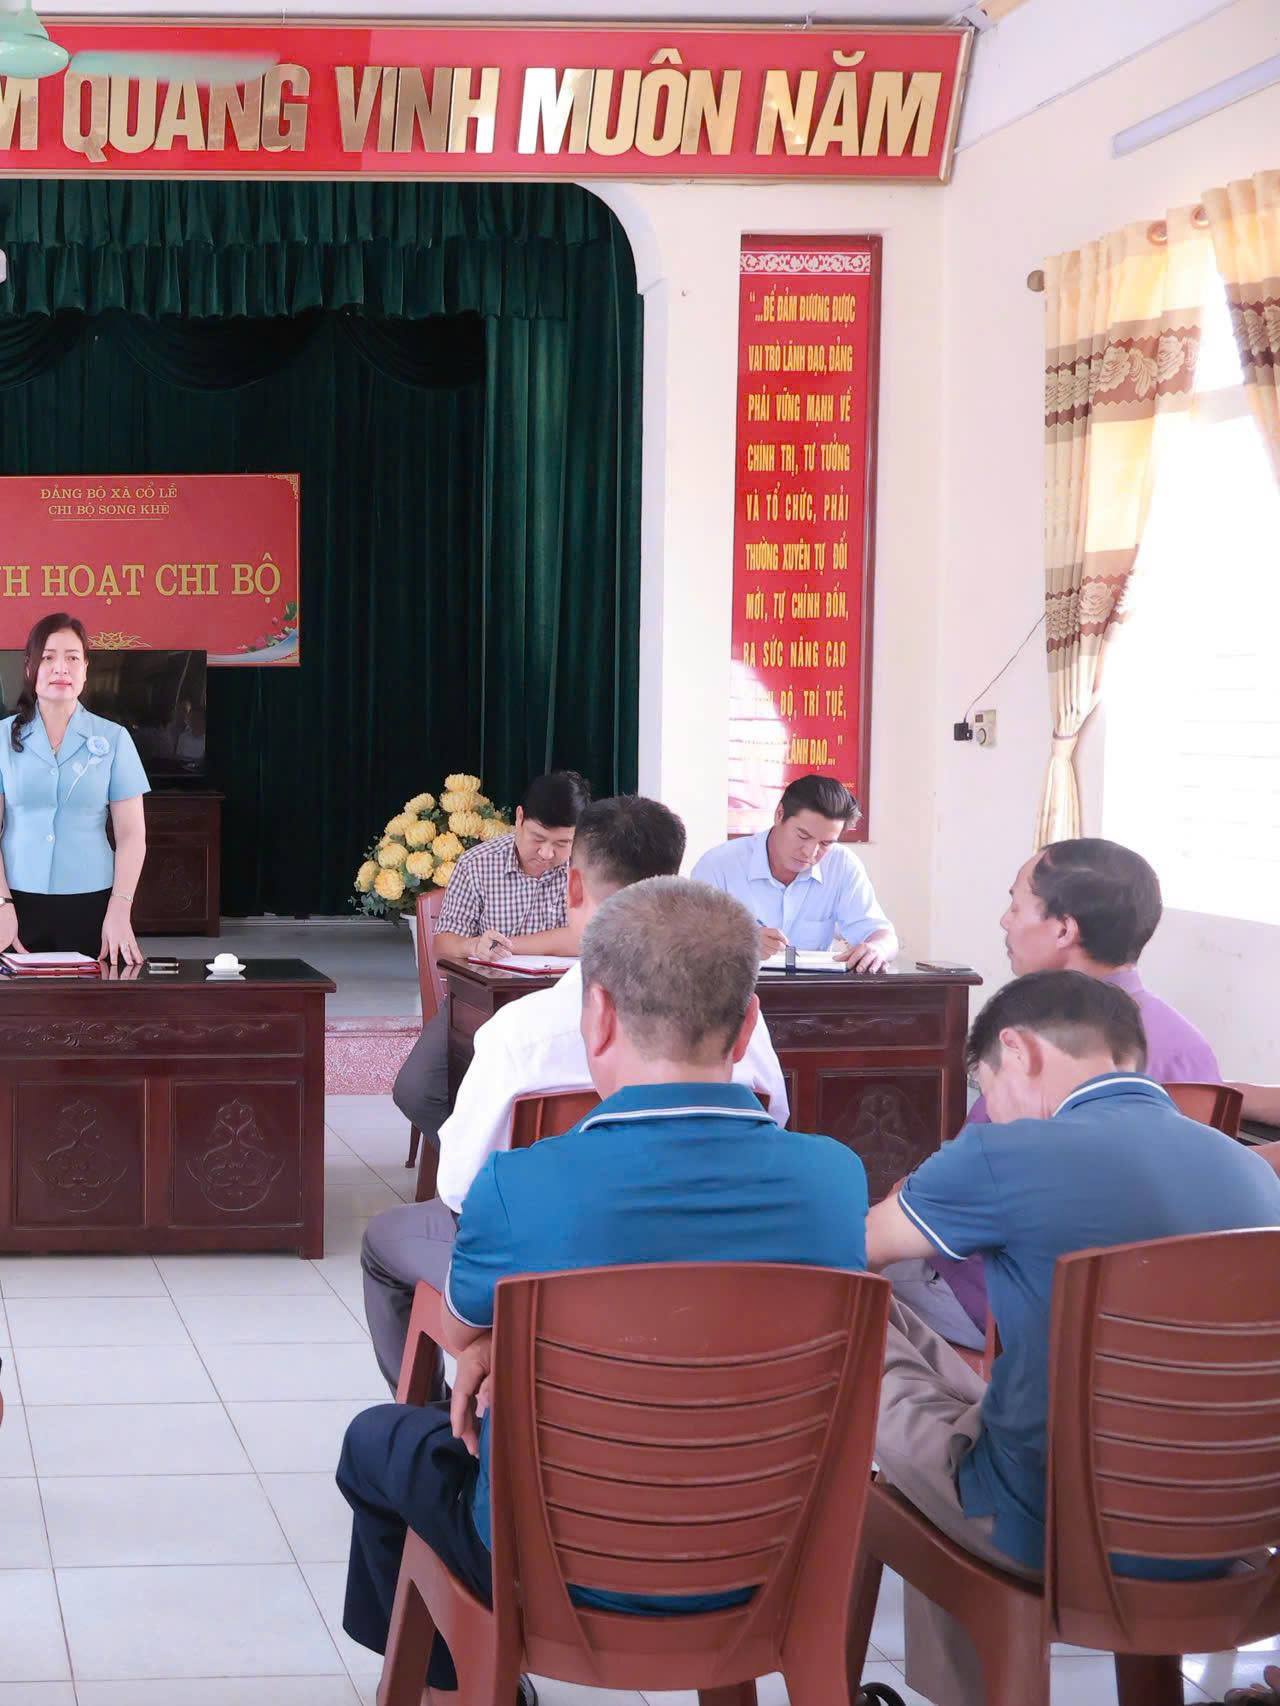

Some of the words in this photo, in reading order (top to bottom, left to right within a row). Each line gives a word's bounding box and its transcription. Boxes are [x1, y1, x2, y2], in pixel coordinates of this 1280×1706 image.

[62, 63, 310, 162] QUANG
[335, 65, 501, 154] VINH
[518, 48, 742, 156] MUÔN
[756, 50, 942, 156] NĂM
[776, 287, 797, 321] ĐẢM
[799, 293, 830, 322] ĐƯƠNG
[832, 293, 856, 328] ĐƯỢC
[748, 345, 763, 371] VAI
[764, 340, 780, 371] TRÒ
[783, 340, 805, 371] LÃNH
[829, 336, 853, 371] ĐẢNG
[748, 384, 770, 421] PHẢI
[776, 387, 800, 421] VỮNG
[806, 394, 834, 427] MẠNH
[747, 440, 775, 471] CHÍNH
[803, 442, 816, 471] TƯ
[821, 432, 850, 471] TƯỞNG
[40, 483, 82, 499] ĐẢNG
[87, 486, 106, 501] BỘ
[110, 486, 131, 498] XÃ
[135, 481, 155, 498] CỔ
[48, 505, 72, 515] CHI
[77, 502, 95, 517] BỘ
[98, 504, 136, 515] SONG
[746, 489, 760, 521] VÀ
[766, 481, 780, 521] TỔ
[785, 487, 817, 524] CHỨC,
[823, 485, 849, 521] PHẢI
[745, 536, 779, 570] THƯỜNG
[782, 538, 811, 570] XUYÊN
[814, 542, 826, 575] TỰ
[832, 530, 848, 569] ĐỔI
[40, 564, 145, 605] HOẠT
[155, 563, 220, 595] CHI
[231, 552, 281, 604] BỘ
[745, 586, 768, 622] MỚI,
[773, 591, 786, 624] TỰ
[791, 584, 820, 618] CHỈNH
[743, 642, 756, 667] RA
[763, 634, 784, 667] SỨC
[790, 635, 819, 667] NÂNG
[825, 640, 847, 667] CAO
[803, 684, 820, 716] TRÍ
